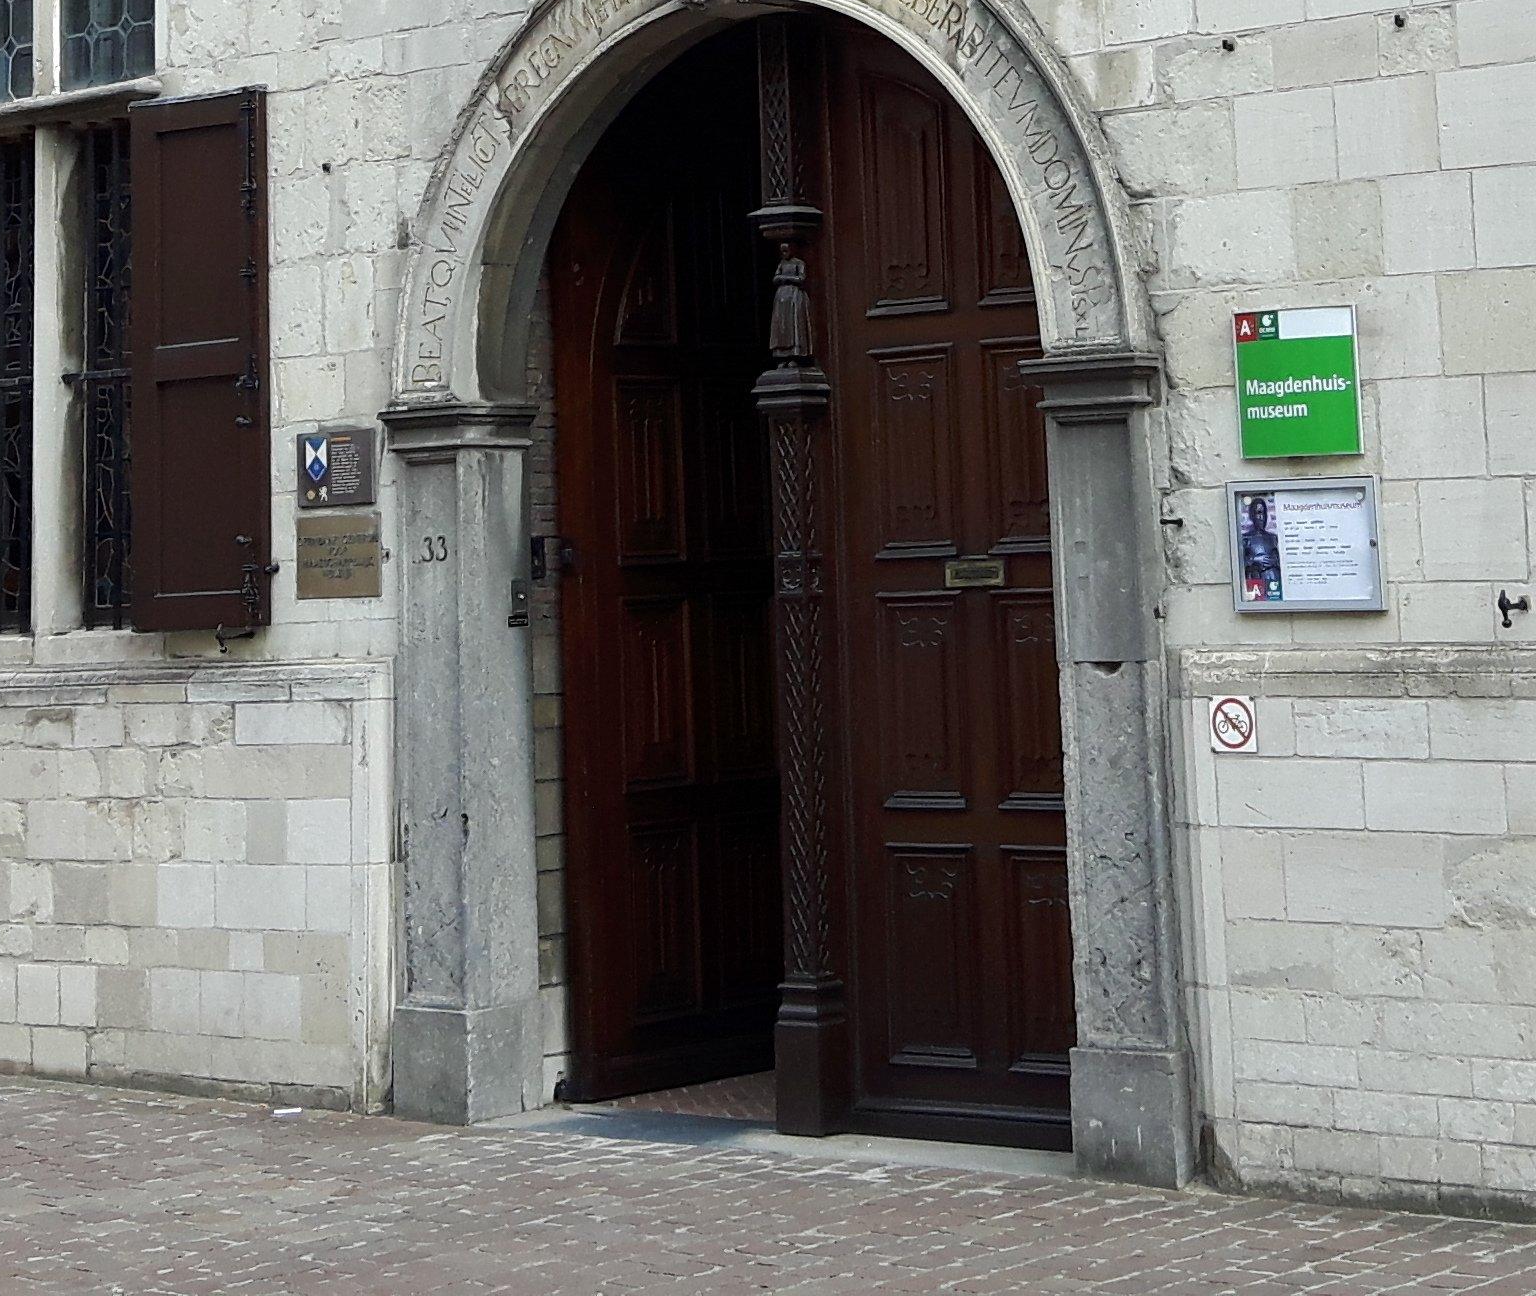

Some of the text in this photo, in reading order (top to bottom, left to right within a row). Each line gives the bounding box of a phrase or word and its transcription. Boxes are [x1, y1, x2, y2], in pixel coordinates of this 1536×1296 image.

[1246, 373, 1352, 398] Maagdenhuis-
[1247, 403, 1308, 420] museum
[420, 535, 448, 562] 33
